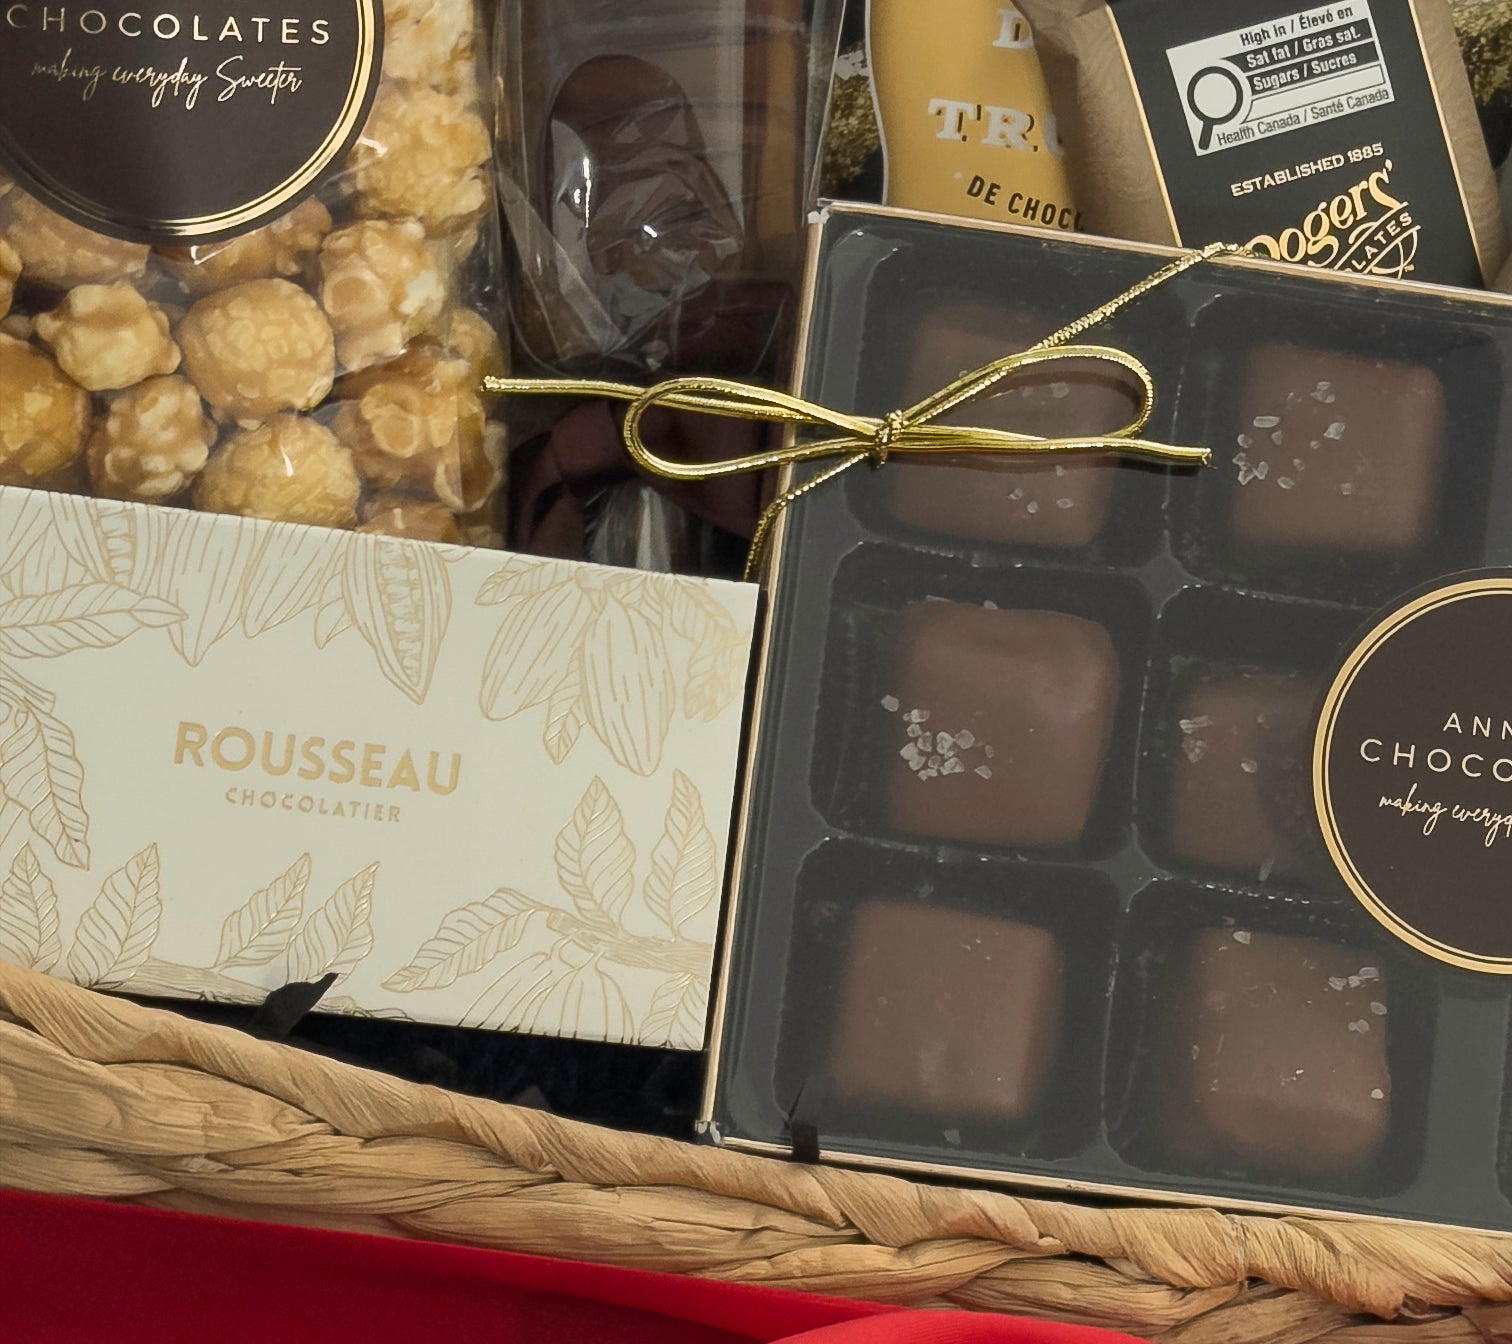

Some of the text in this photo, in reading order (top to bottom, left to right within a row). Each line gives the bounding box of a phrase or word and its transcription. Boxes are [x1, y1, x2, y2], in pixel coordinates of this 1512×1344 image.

[6, 4, 330, 45] CHOCOLATES
[1239, 26, 1272, 48] High
[1299, 13, 1334, 30] Élevé
[1337, 6, 1354, 20] en
[1246, 50, 1271, 69] Sat
[1272, 44, 1291, 61] fat
[1302, 32, 1334, 53] Gras
[1336, 25, 1362, 42] sat.
[111, 56, 208, 111] everyday
[216, 54, 303, 105] Sweeter
[1252, 67, 1300, 92] Sugars
[1311, 52, 1357, 74] Sucres
[1216, 122, 1256, 147] Health
[1257, 113, 1301, 135] Canada
[1310, 98, 1345, 119] Santé
[1346, 87, 1390, 109] Canada
[966, 175, 1001, 206] DE
[1230, 141, 1384, 197] ESTABLISHED 1885
[172, 721, 462, 796] ROUSSEAU
[225, 786, 401, 823] CHOCOLATIER
[1379, 783, 1448, 836] making
